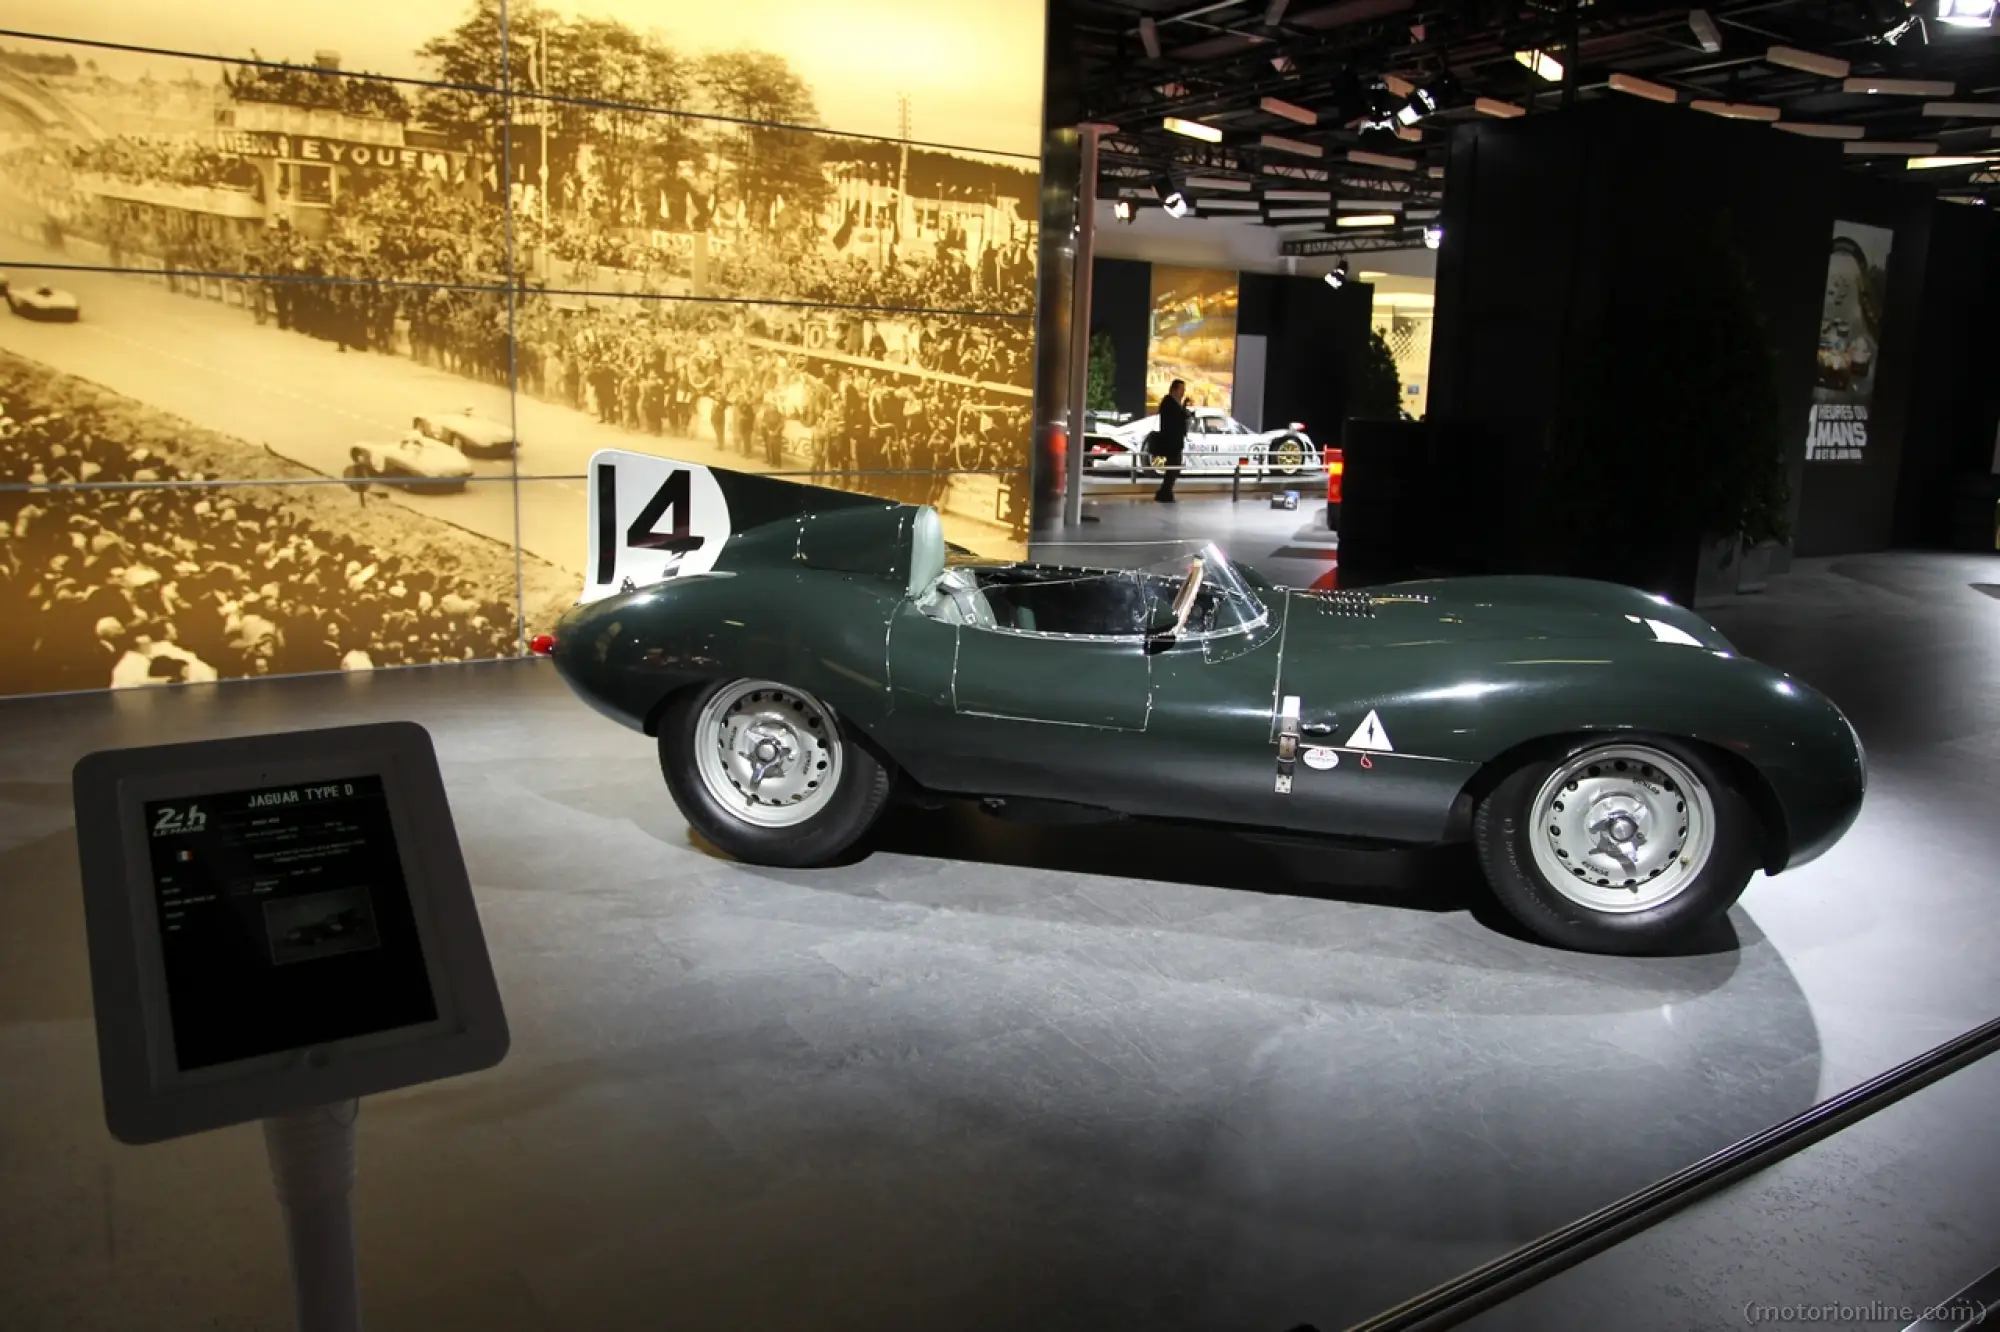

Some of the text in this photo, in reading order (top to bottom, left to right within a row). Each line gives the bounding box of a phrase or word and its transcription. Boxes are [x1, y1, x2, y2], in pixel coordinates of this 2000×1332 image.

[1816, 421, 1867, 447] MANS
[597, 464, 705, 585] 14
[248, 783, 354, 807] JAGUAR TYPE D
